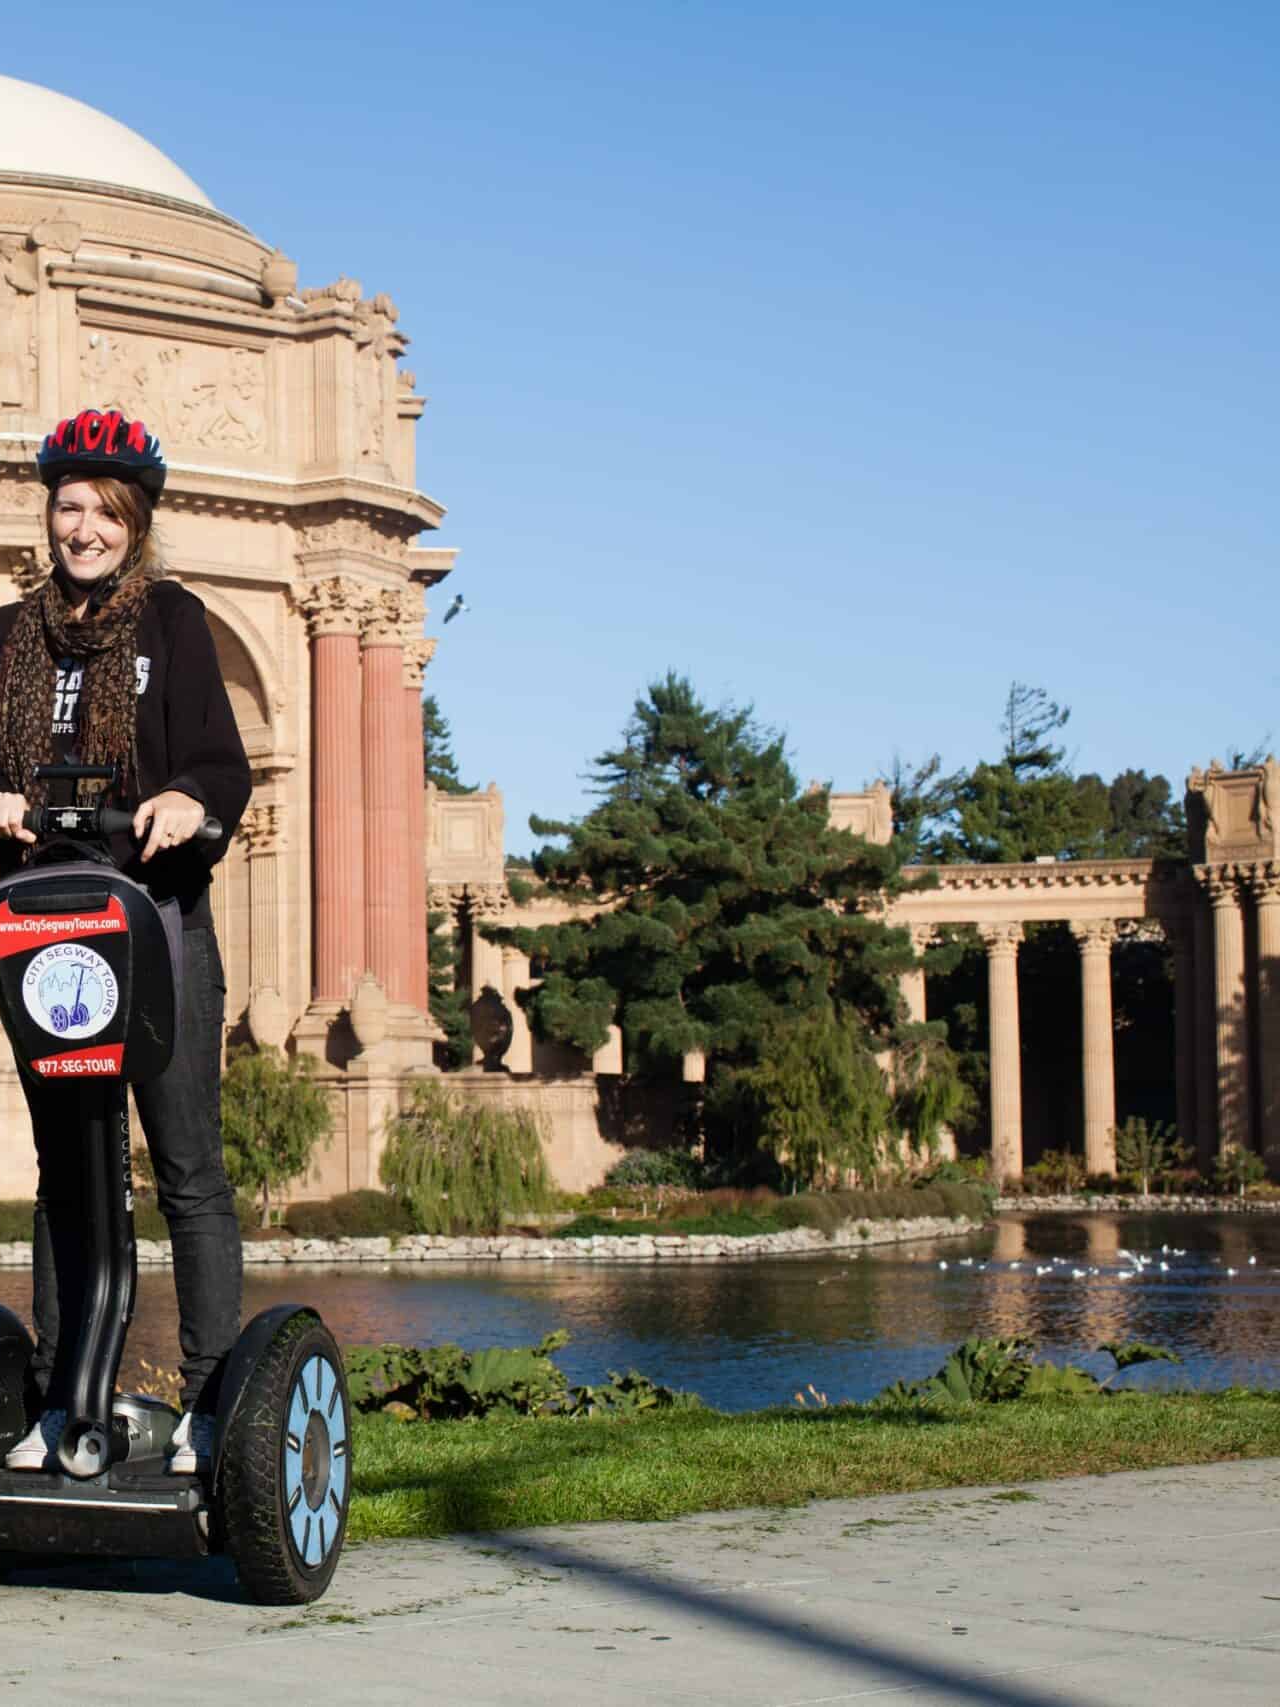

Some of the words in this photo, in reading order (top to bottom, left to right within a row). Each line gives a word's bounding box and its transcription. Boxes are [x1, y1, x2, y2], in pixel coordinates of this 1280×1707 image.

[0, 918, 120, 933] www.CitySegwayTours.com
[26, 960, 45, 985] CITY
[47, 946, 106, 968] SEGWAY
[101, 970, 116, 1017] TOURS
[38, 1059, 116, 1073] 877-SEG-TOUR
